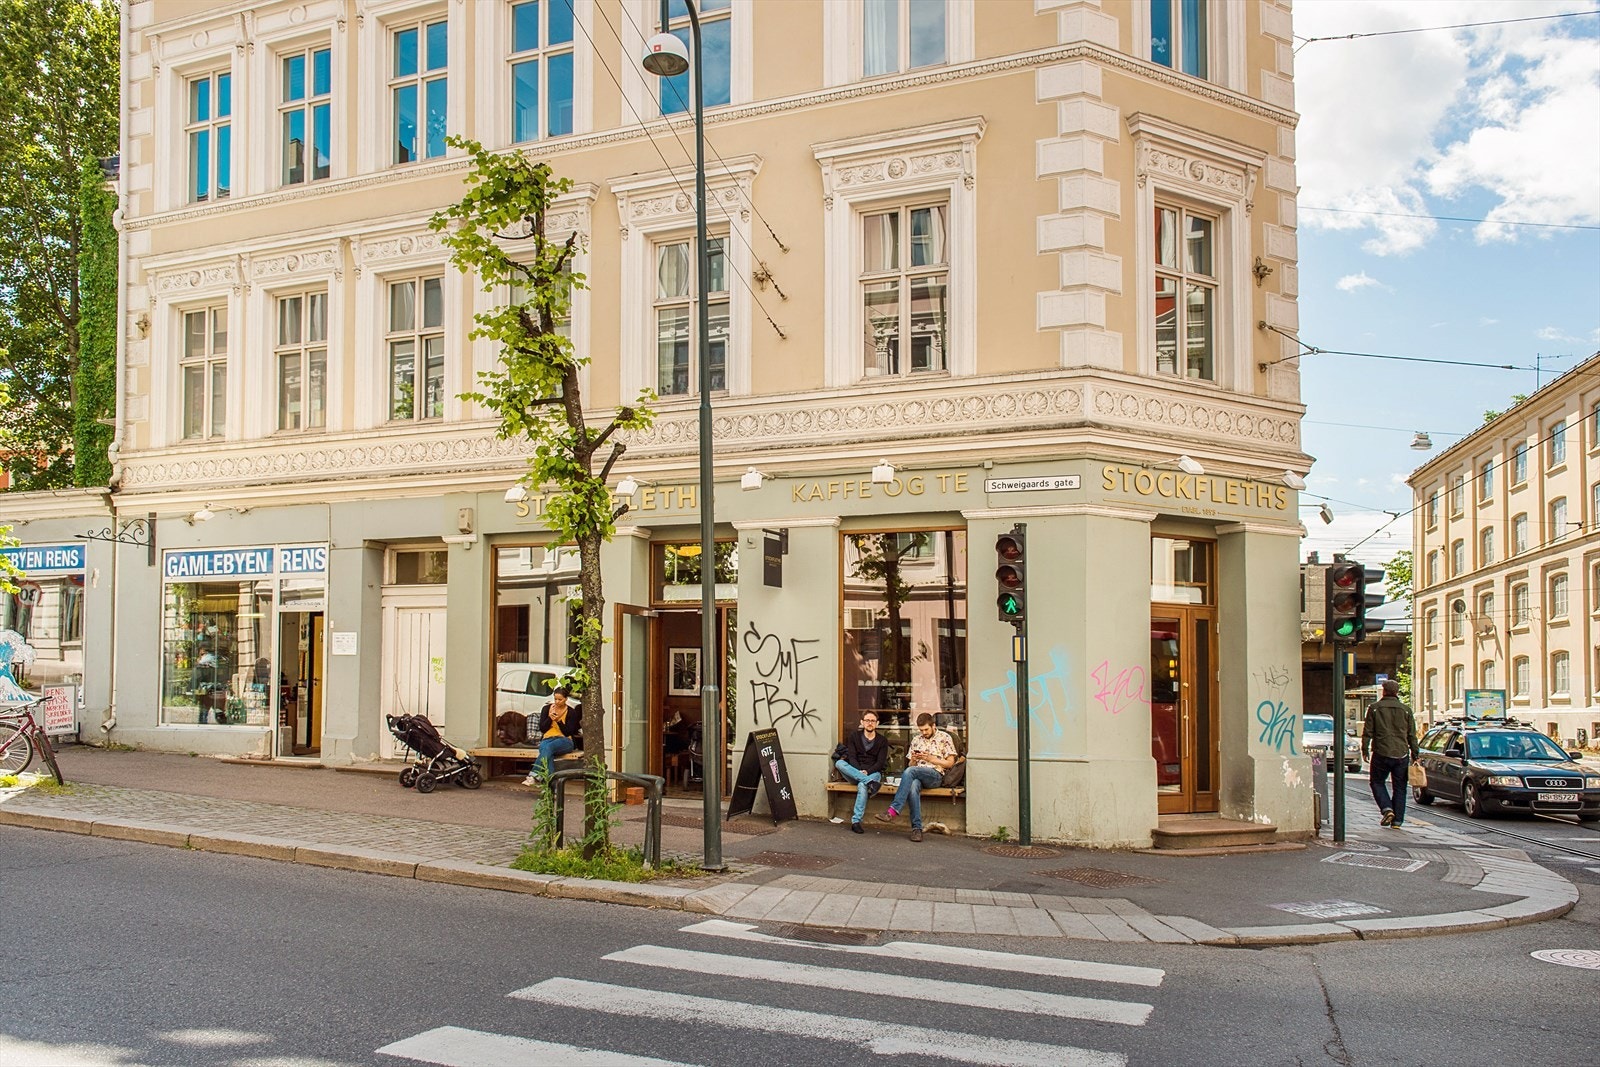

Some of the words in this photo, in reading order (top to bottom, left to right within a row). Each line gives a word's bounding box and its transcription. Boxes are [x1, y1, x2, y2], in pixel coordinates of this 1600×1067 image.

[792, 479, 874, 502] KAFFE
[883, 475, 926, 497] OG
[936, 472, 968, 493] TE
[991, 480, 1050, 490] Schweigaards
[1054, 480, 1074, 488] gate
[1102, 464, 1289, 511] STOCKFLETHS
[46, 549, 79, 567] RENS
[167, 551, 267, 577] GAMLEBYEN
[281, 547, 326, 572] RENS
